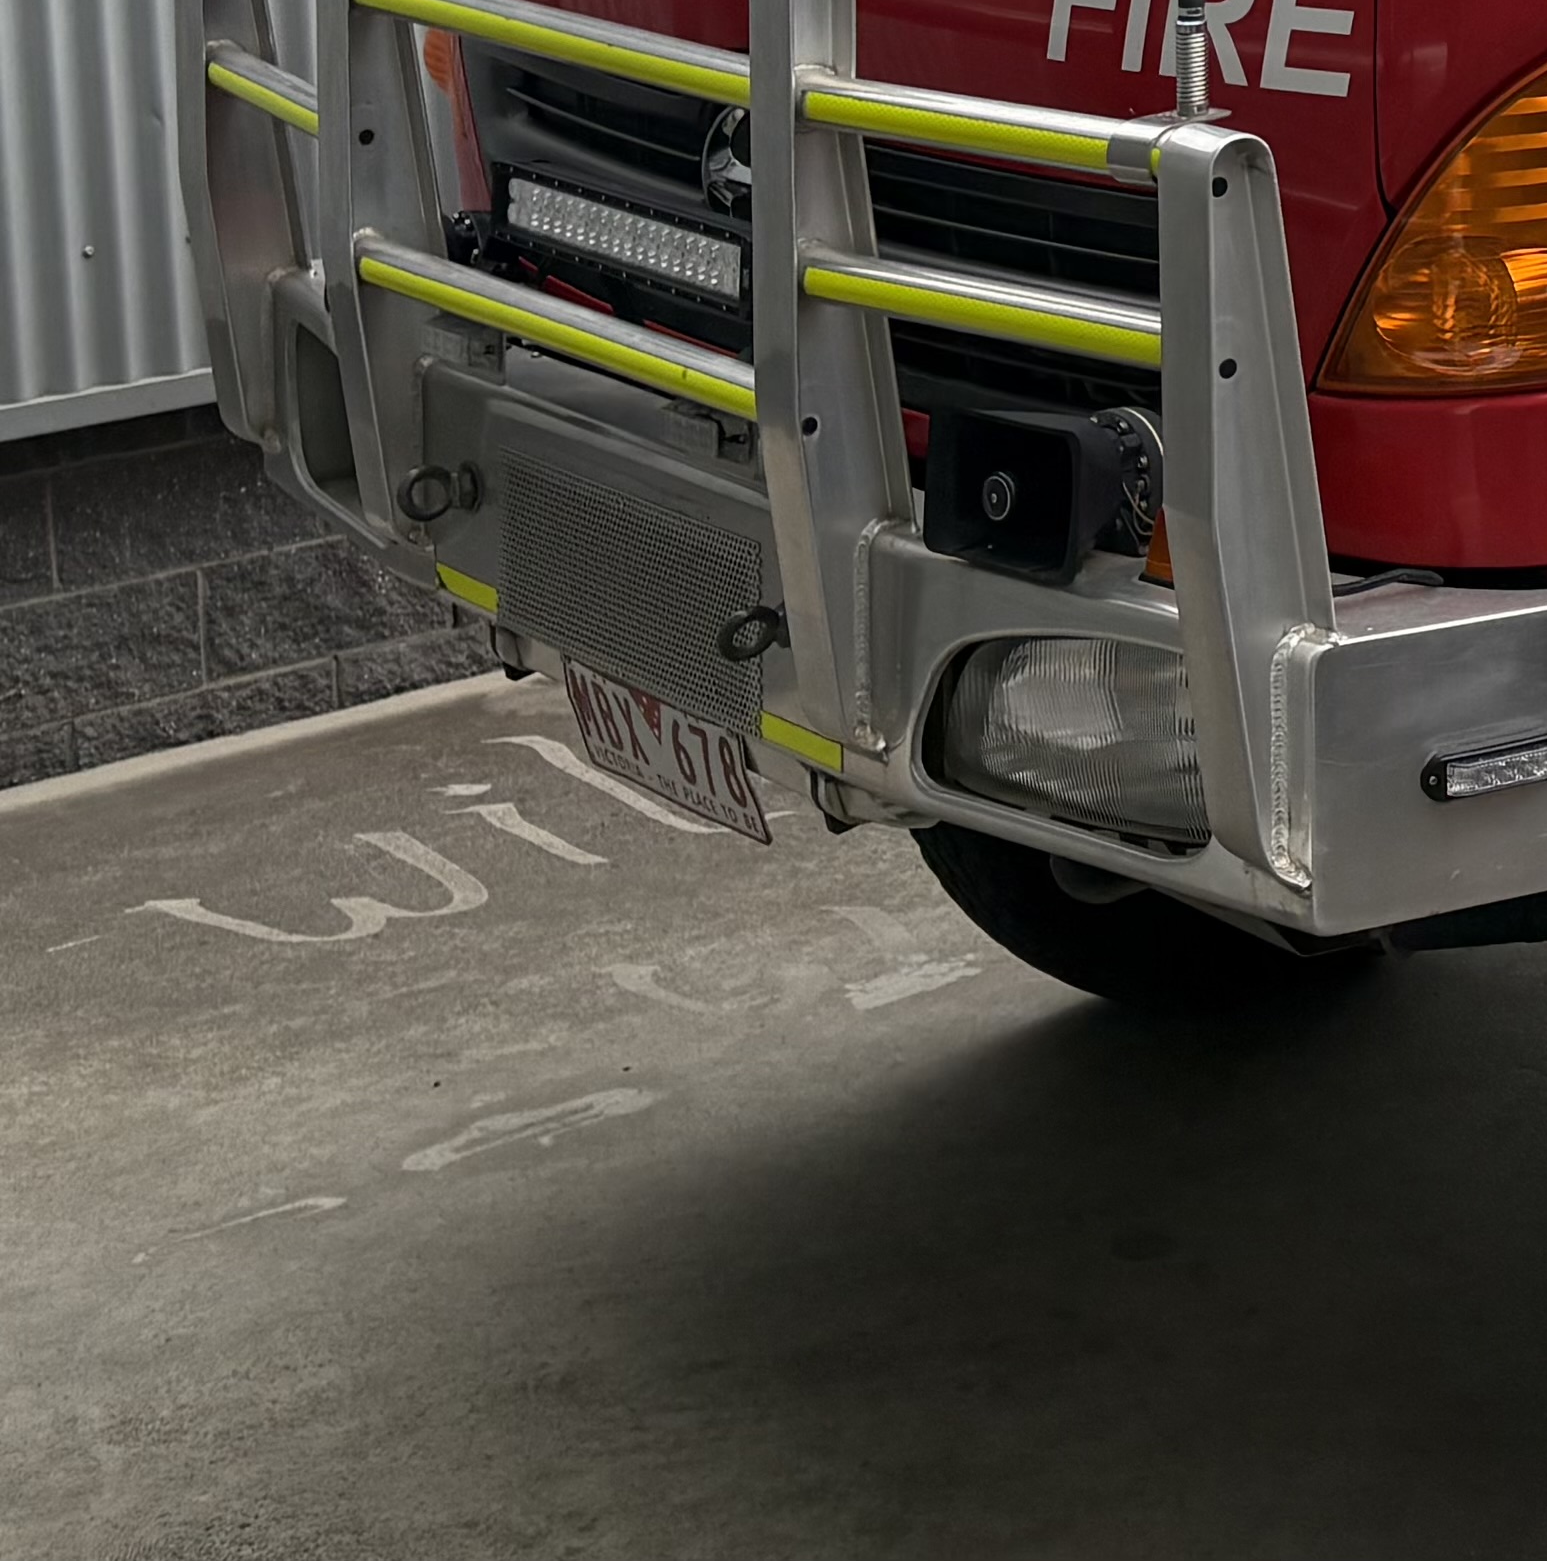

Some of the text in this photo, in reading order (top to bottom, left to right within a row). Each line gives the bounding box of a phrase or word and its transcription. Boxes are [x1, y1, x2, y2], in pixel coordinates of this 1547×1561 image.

[568, 667, 748, 808] MBX 678
[720, 803, 739, 824] TO
